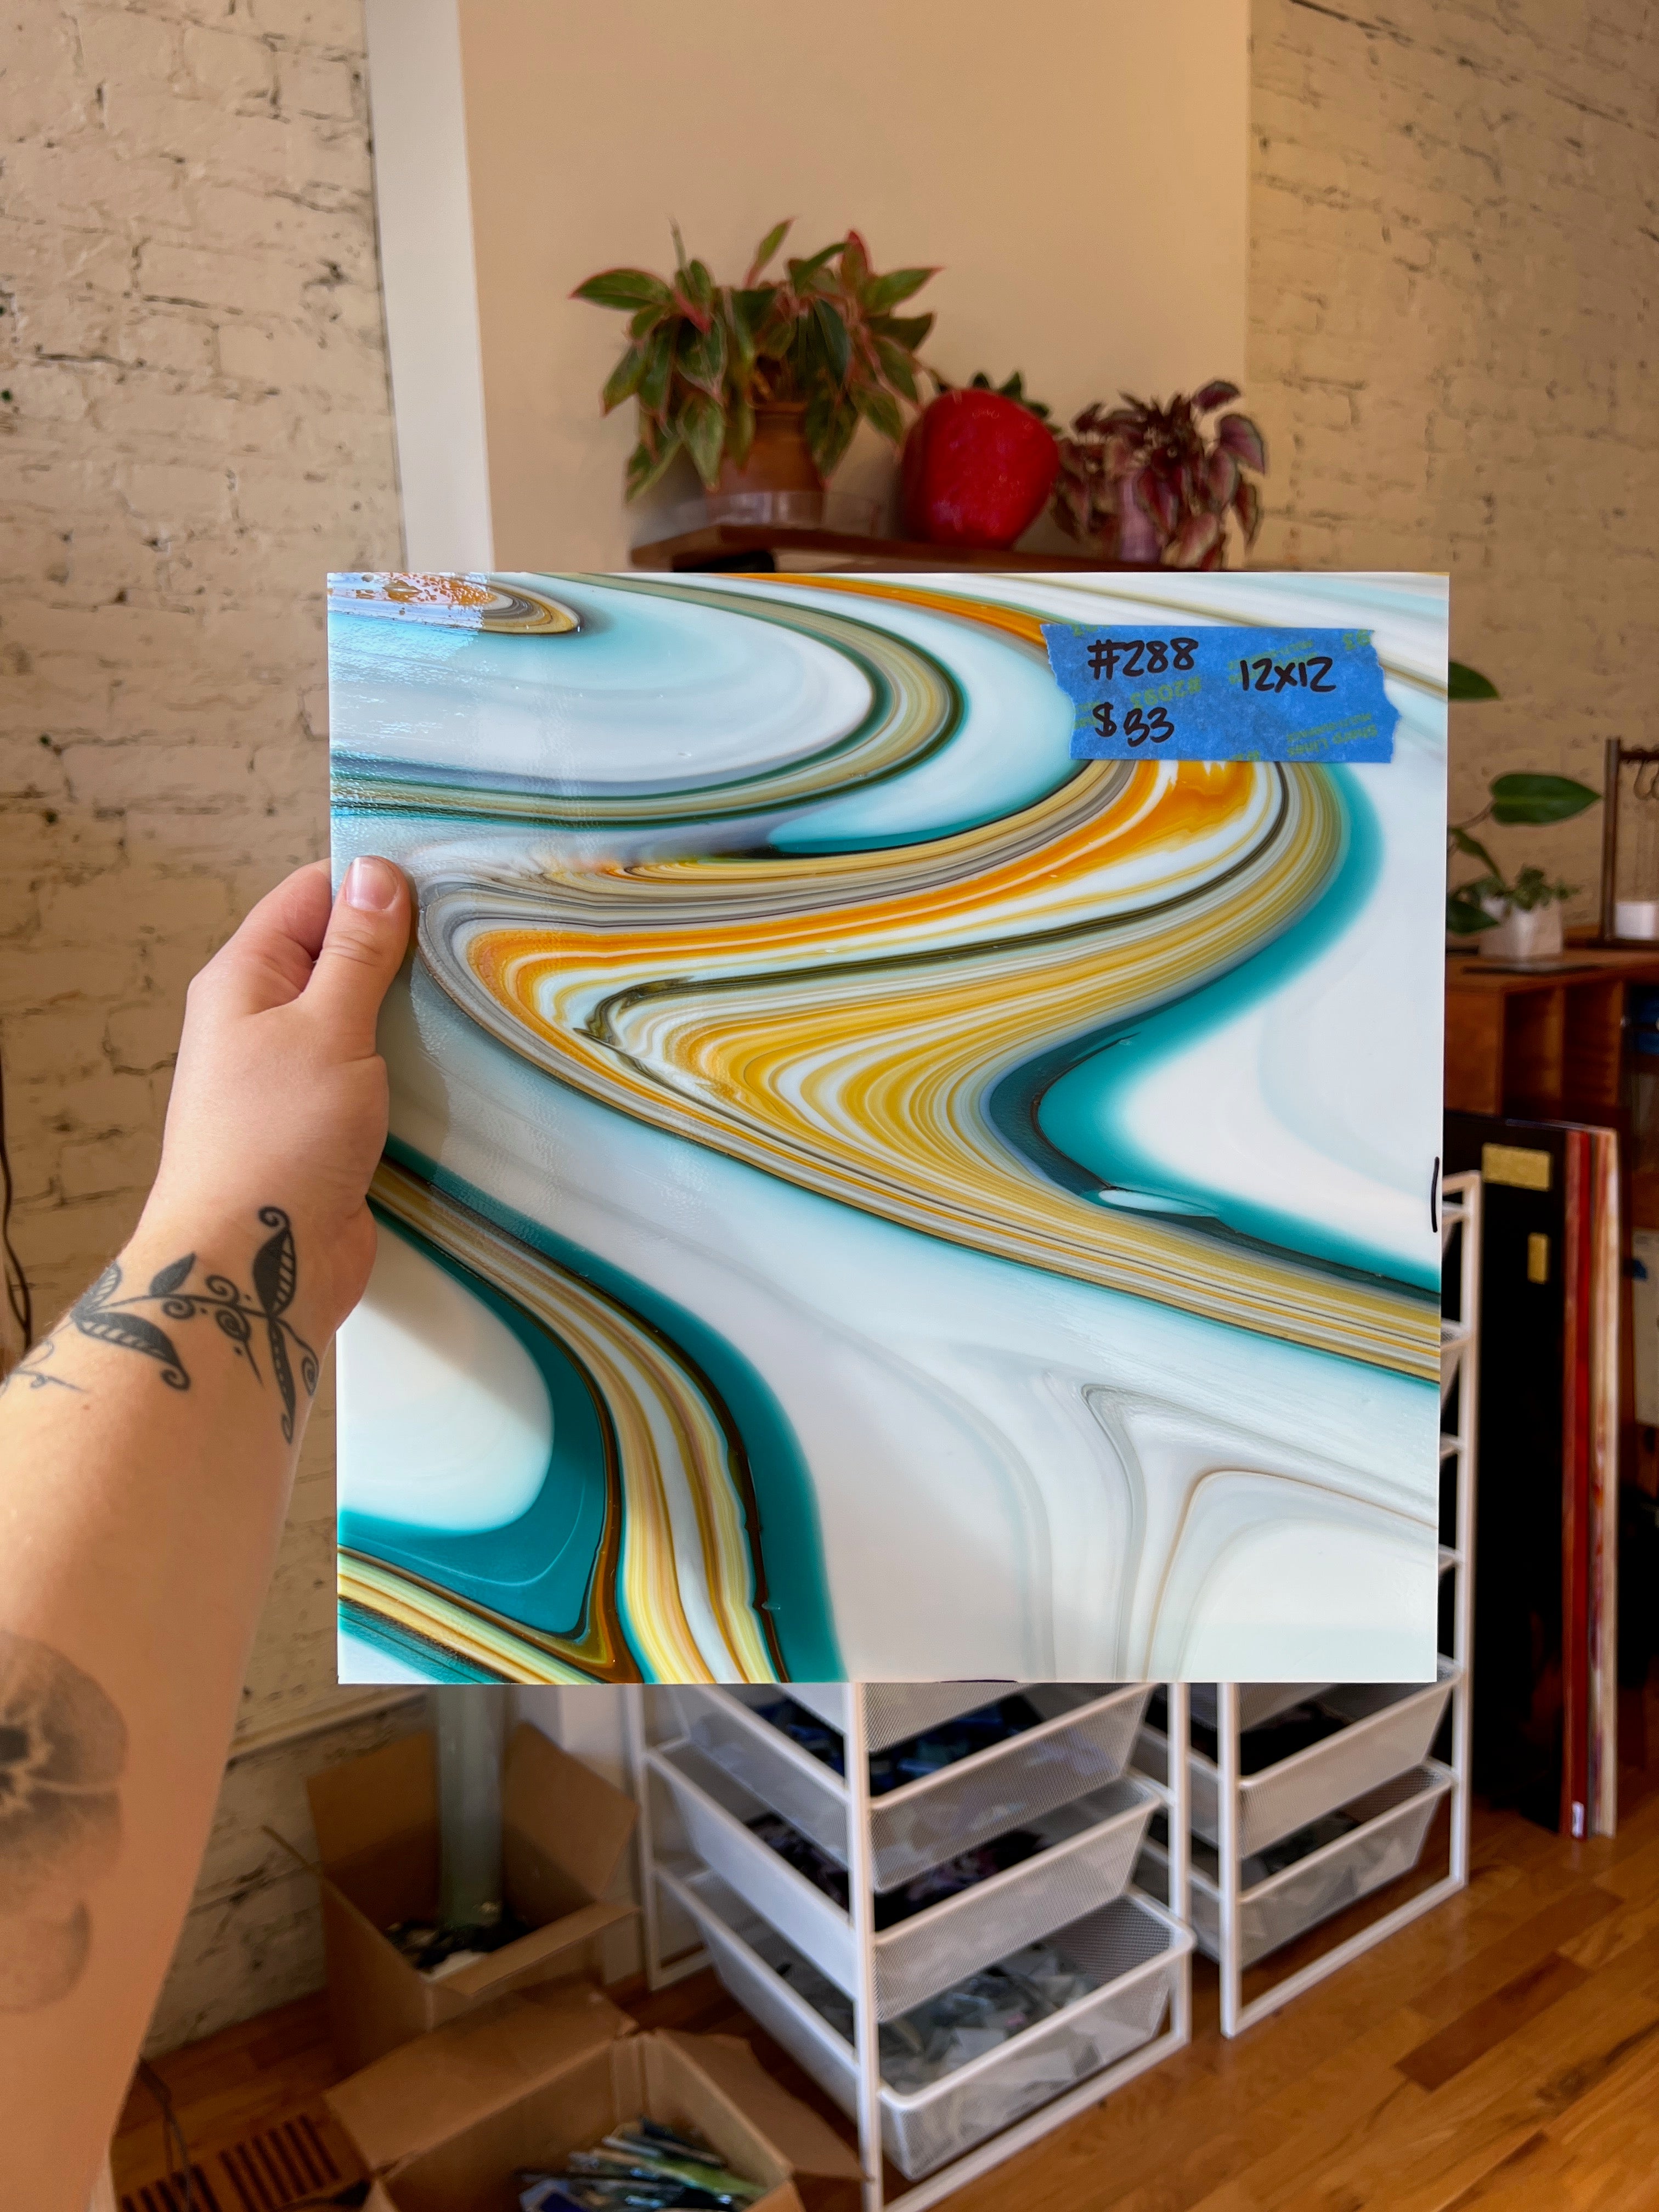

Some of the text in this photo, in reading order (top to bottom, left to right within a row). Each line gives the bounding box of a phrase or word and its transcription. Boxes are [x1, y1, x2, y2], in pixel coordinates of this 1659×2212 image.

[1087, 637, 1199, 680] #288
[1130, 675, 1202, 710] #2093
[1286, 723, 1378, 757] Sharp Lines
